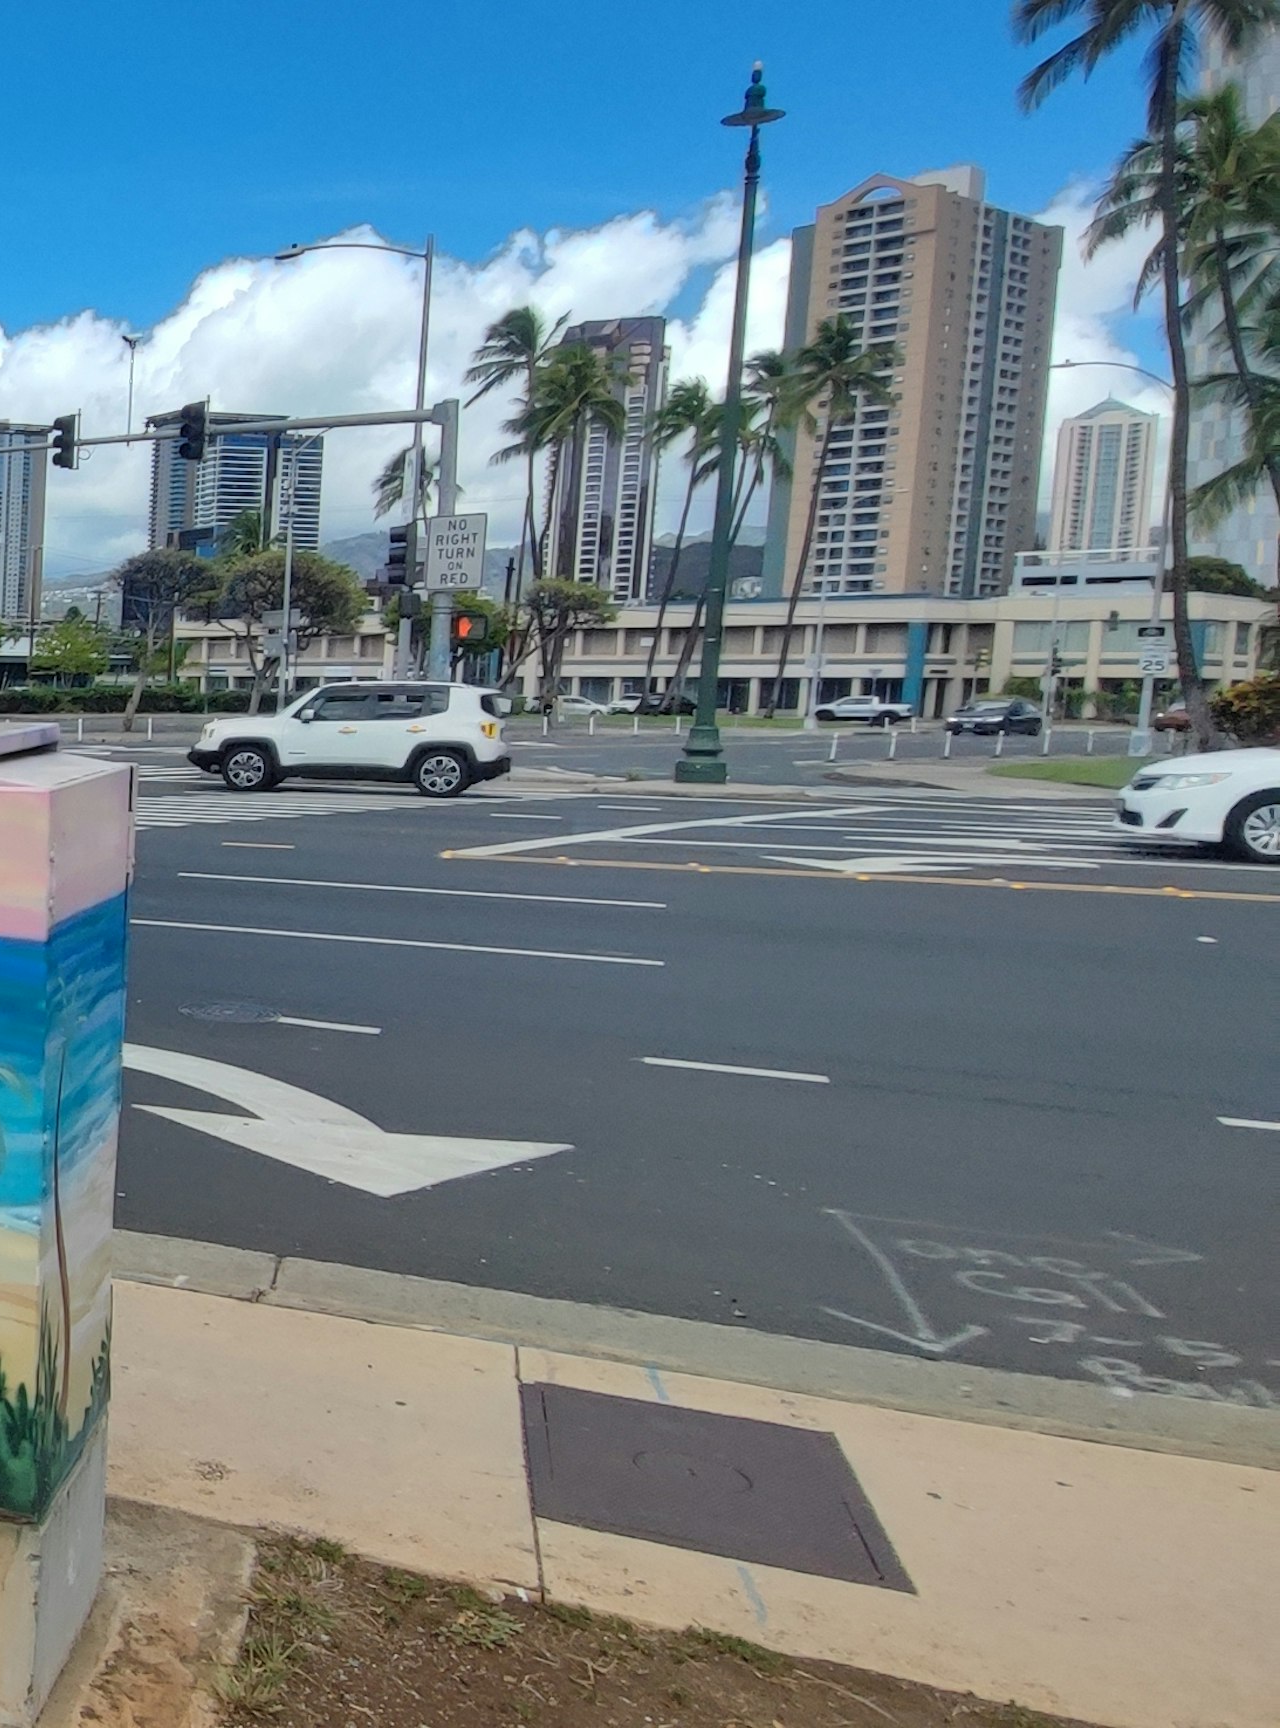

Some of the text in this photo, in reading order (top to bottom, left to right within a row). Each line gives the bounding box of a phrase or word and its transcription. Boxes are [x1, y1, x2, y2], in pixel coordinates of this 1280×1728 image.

[448, 519, 467, 531] NO
[435, 532, 479, 546] RIGHT
[437, 547, 475, 560] TURN
[447, 561, 463, 571] ON
[440, 573, 469, 585] RED
[1142, 660, 1165, 671] 25
